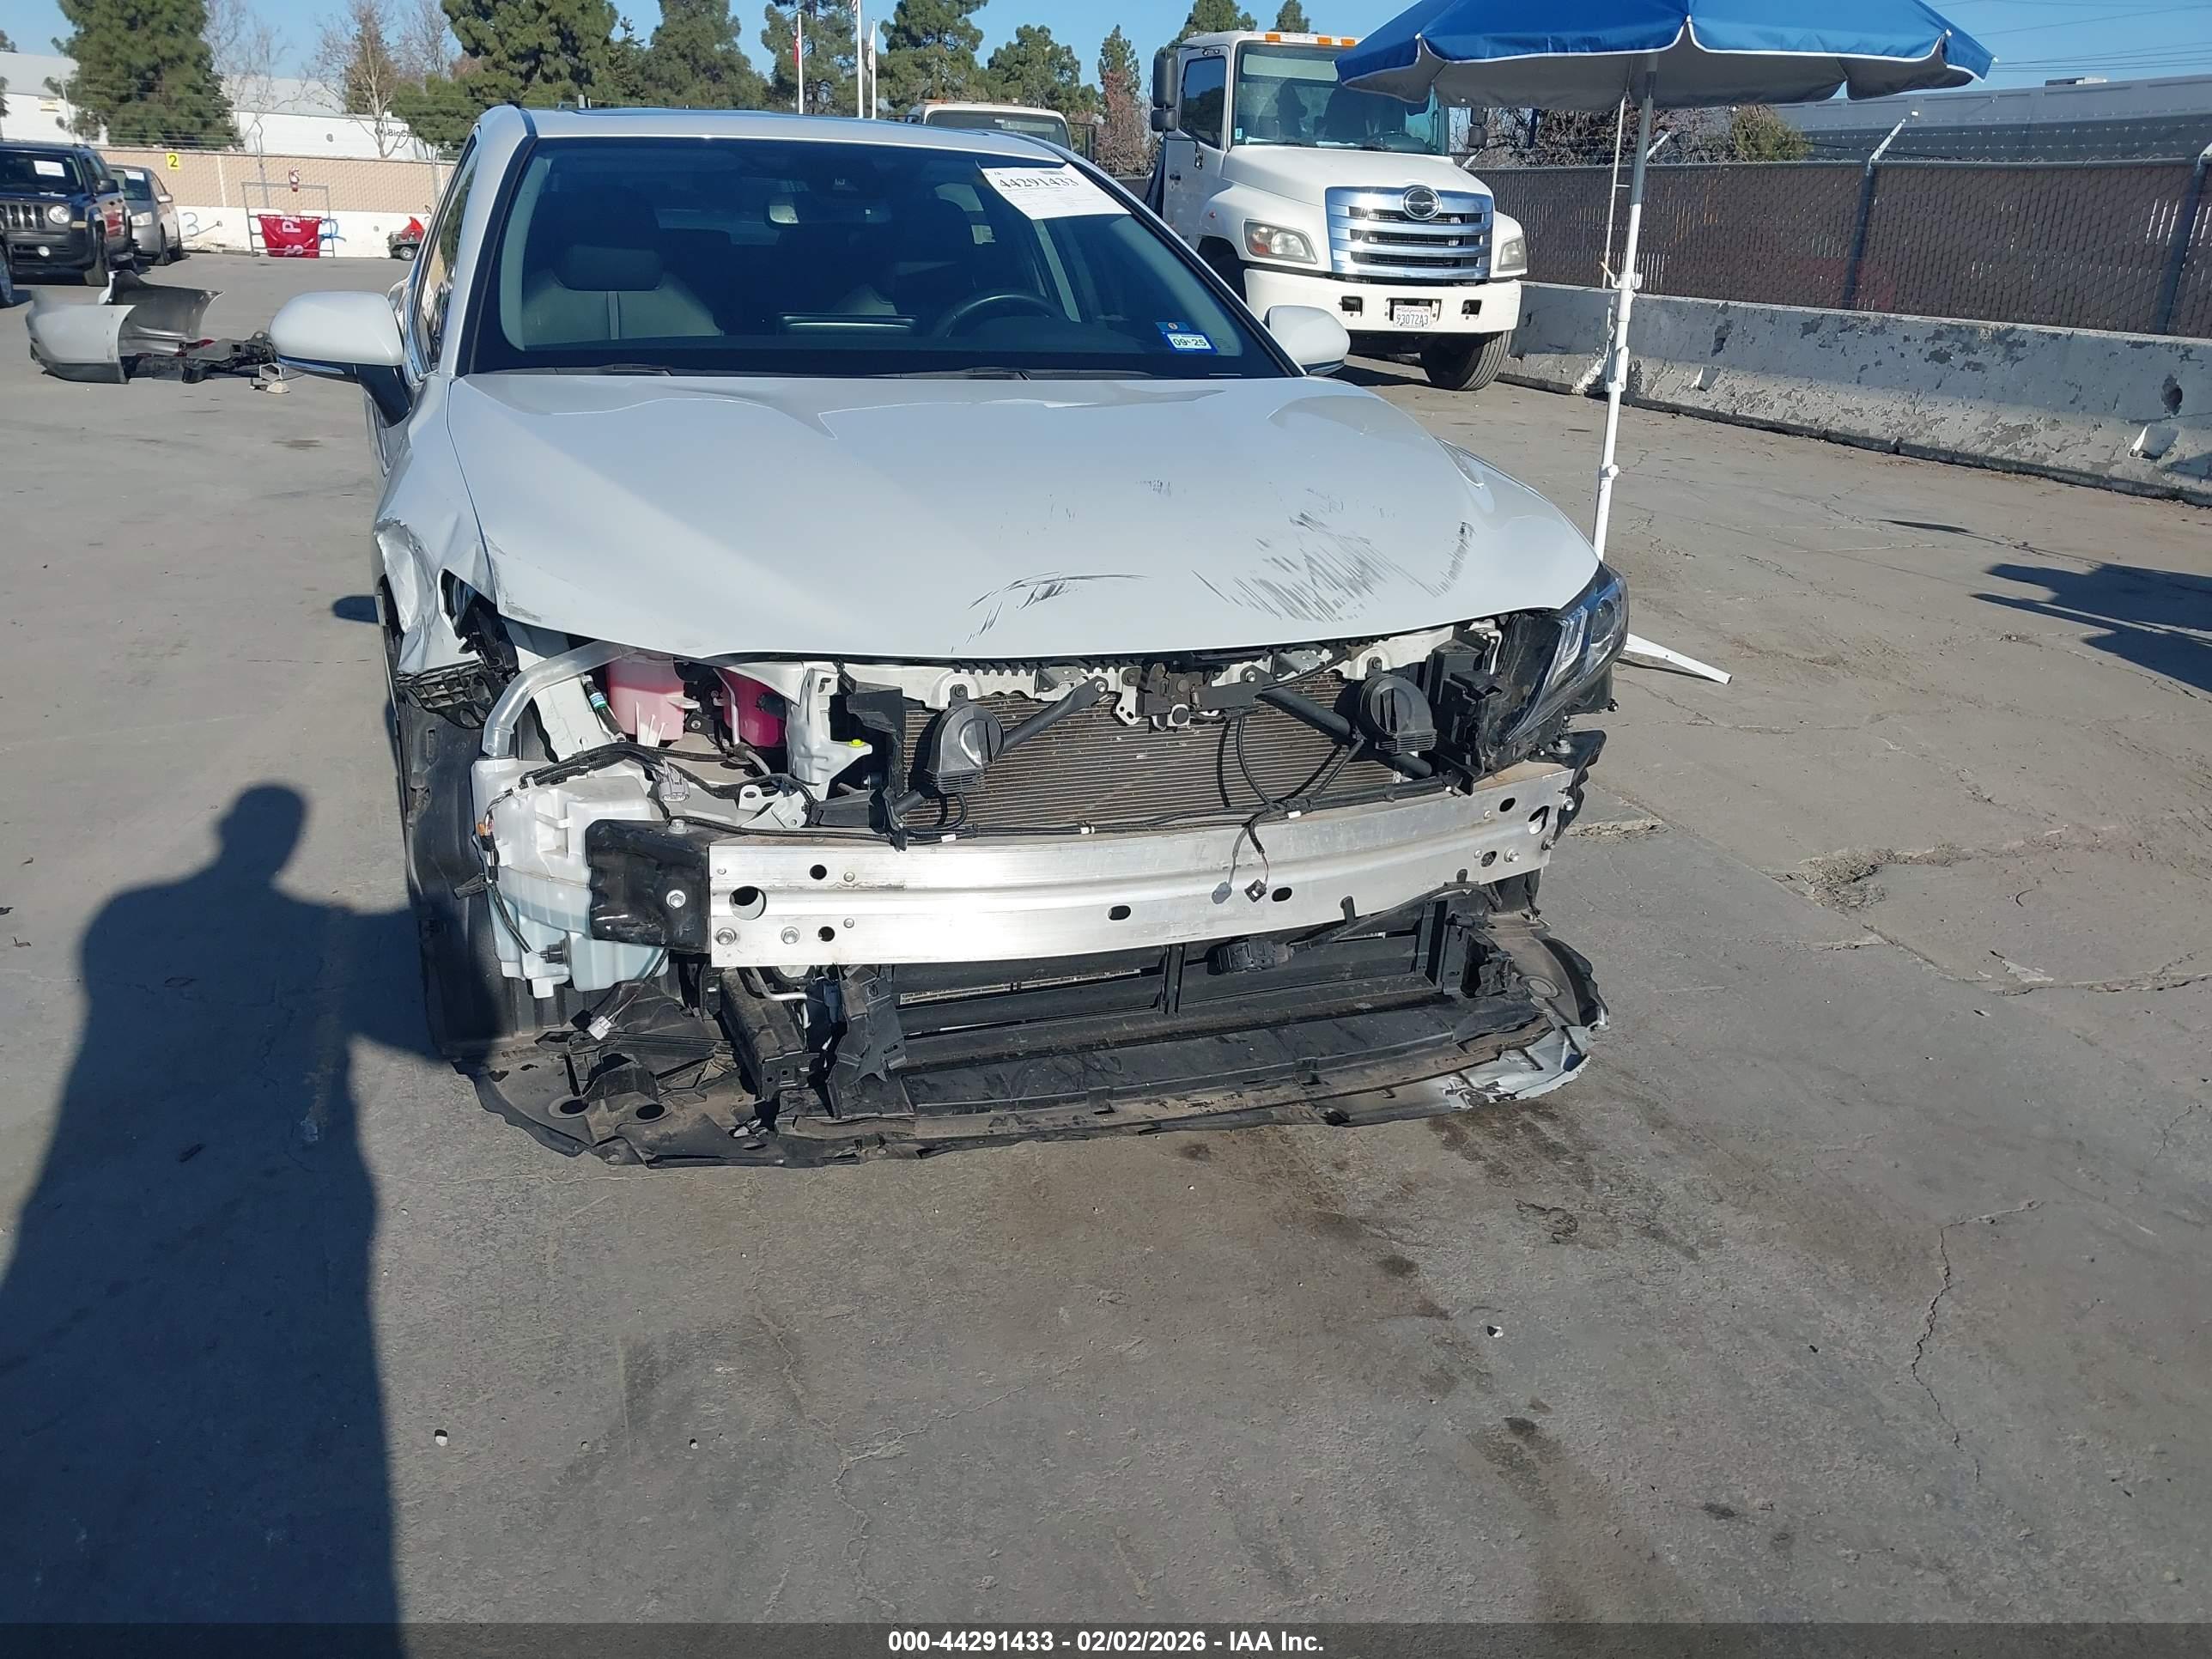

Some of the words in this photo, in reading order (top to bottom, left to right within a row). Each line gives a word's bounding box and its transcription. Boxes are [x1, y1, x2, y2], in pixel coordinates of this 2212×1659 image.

[168, 155, 179, 167] 2
[1000, 178, 1079, 188] 44291433
[1395, 313, 1429, 325] 93072A3
